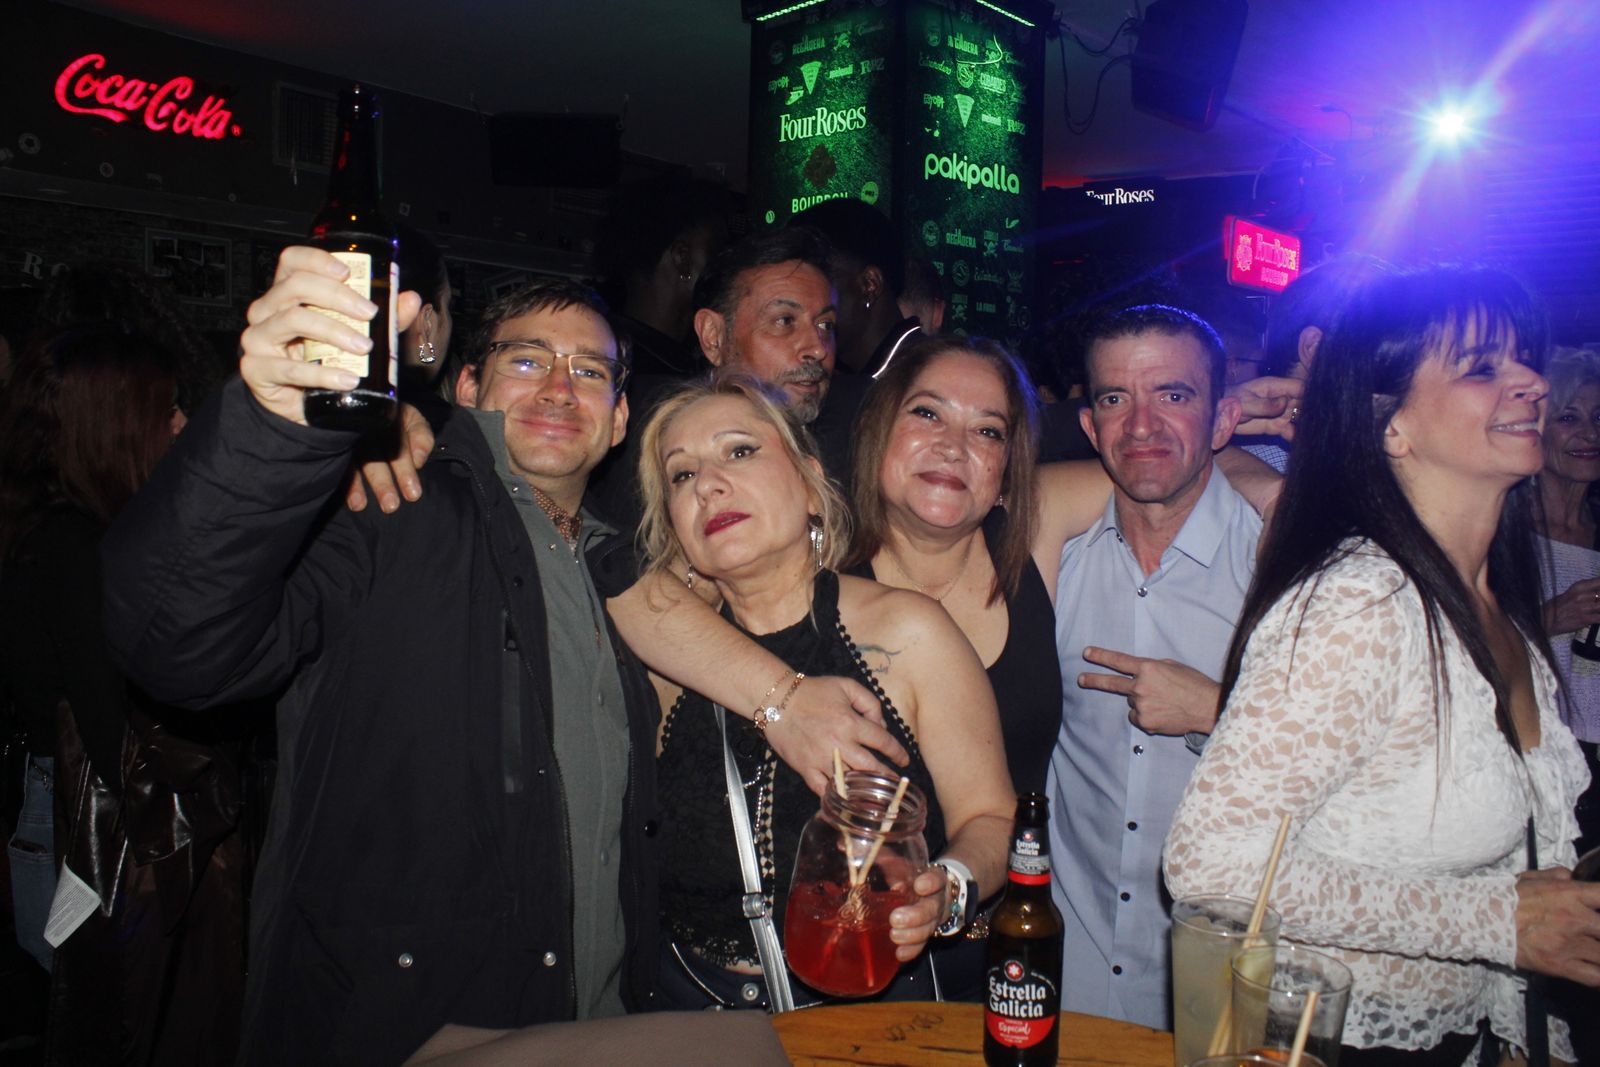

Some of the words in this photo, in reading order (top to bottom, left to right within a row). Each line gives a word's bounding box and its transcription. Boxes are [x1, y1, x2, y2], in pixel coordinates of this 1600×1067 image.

[55, 53, 232, 139] Coca-Cola
[925, 152, 1019, 194] pakipalla
[989, 976, 1046, 1000] Estrella
[989, 993, 1043, 1018] Galicia
